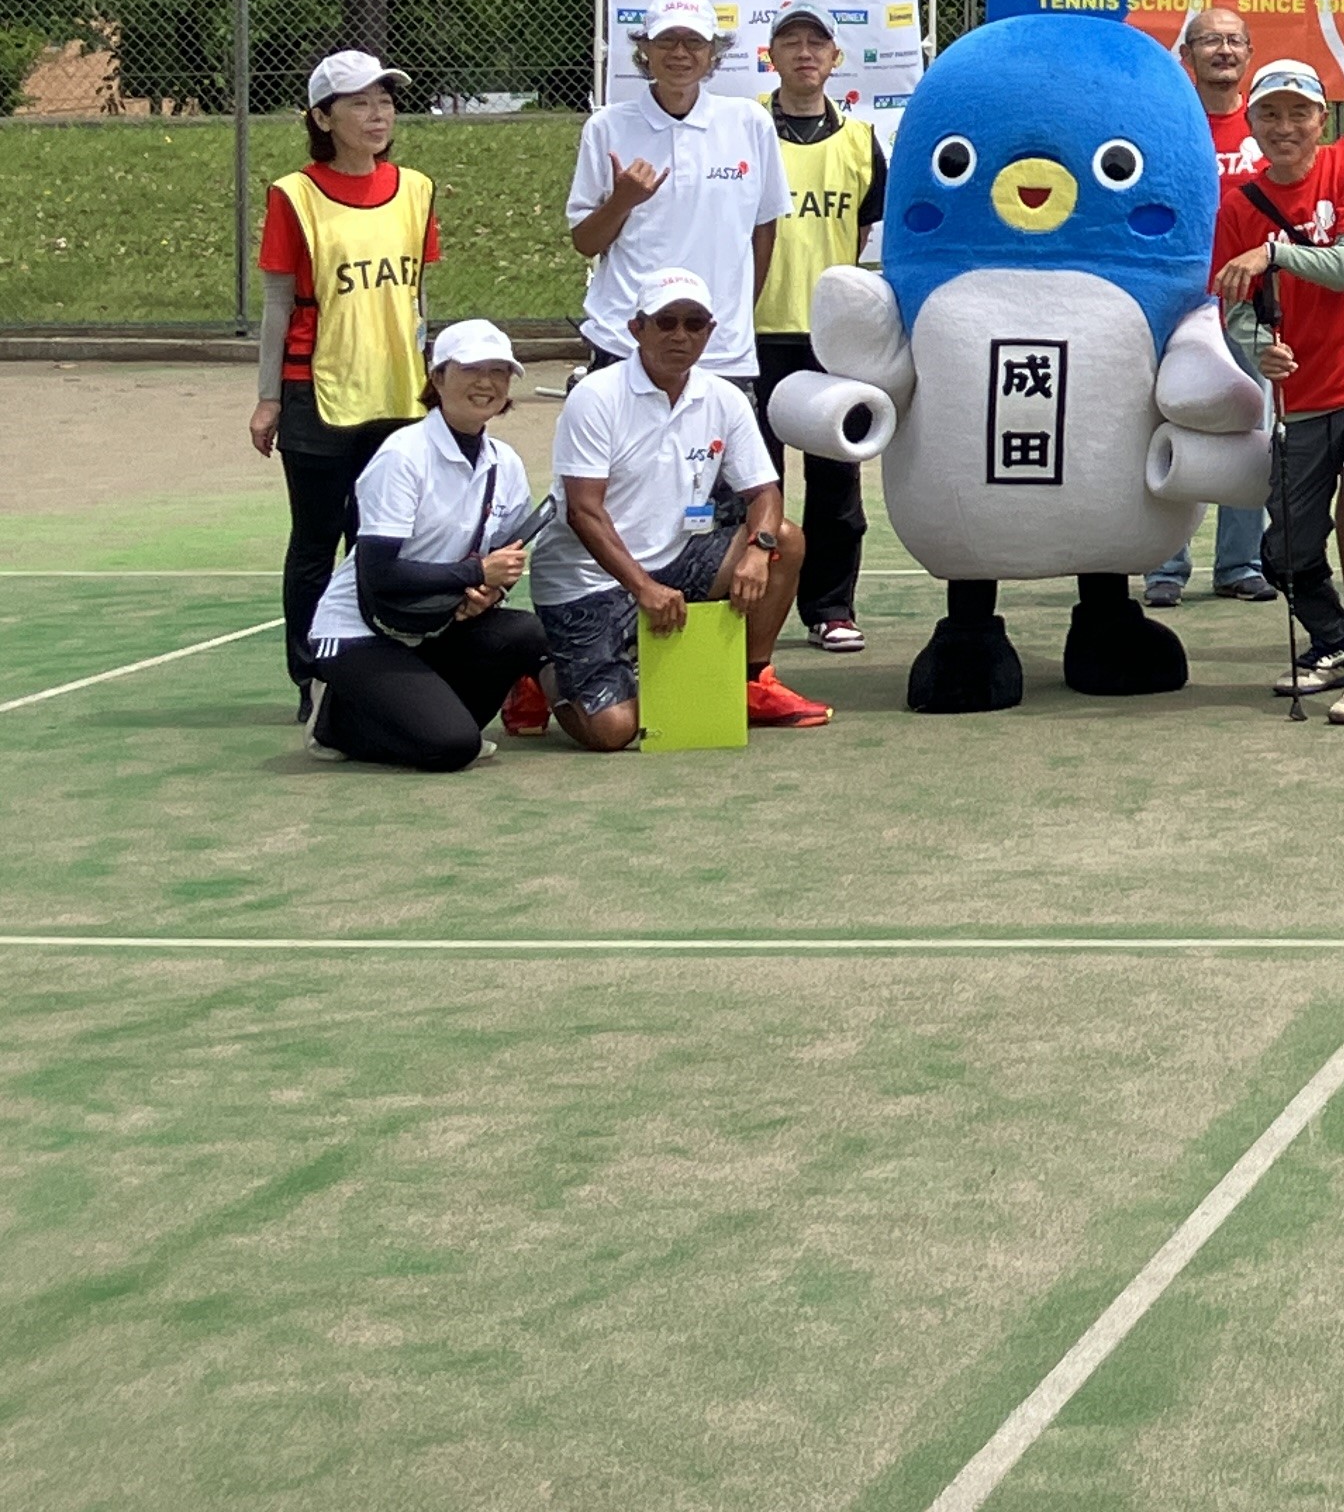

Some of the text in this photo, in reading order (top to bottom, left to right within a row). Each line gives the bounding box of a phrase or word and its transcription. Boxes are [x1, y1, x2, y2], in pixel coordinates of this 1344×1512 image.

[662, 2, 699, 13] JAPAN
[749, 10, 778, 24] JAST
[706, 166, 743, 180] JASTA
[1215, 151, 1257, 174] STA
[785, 191, 852, 219] AFF
[337, 257, 418, 295] STAFF
[1001, 354, 1054, 468] 成田
